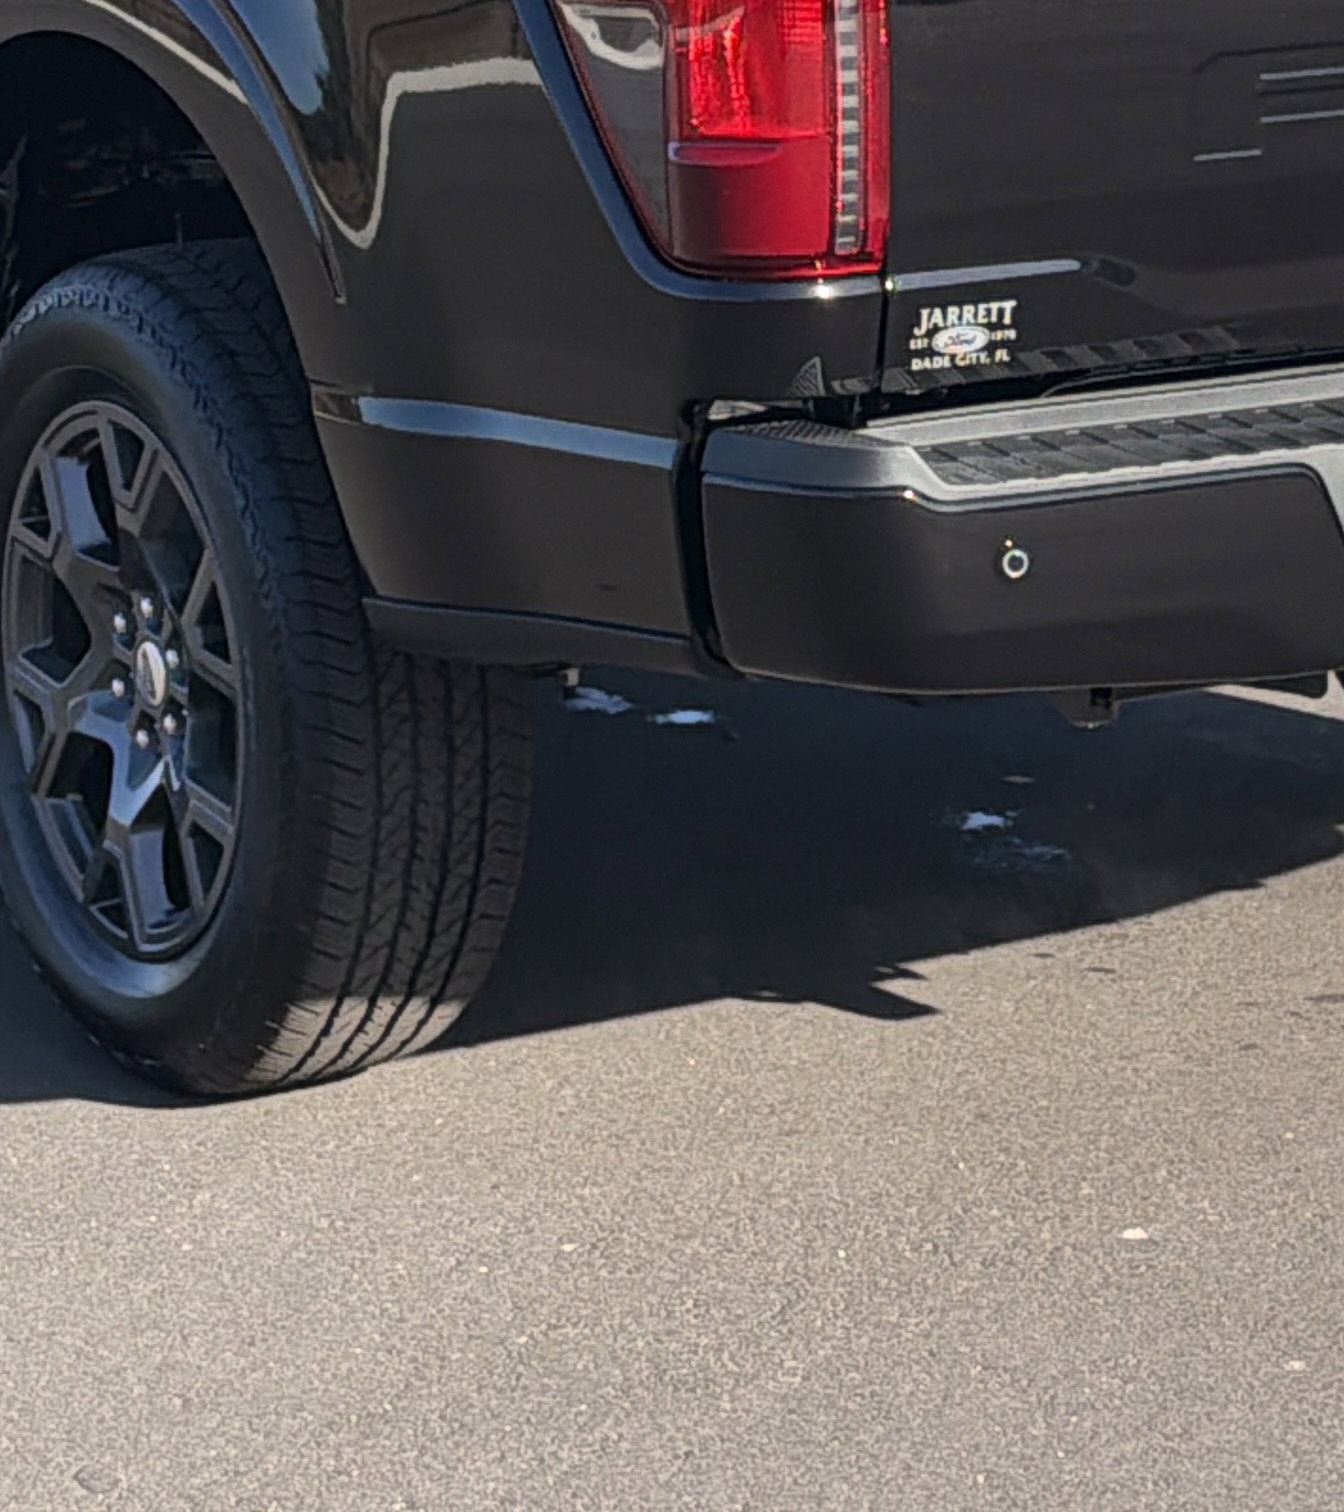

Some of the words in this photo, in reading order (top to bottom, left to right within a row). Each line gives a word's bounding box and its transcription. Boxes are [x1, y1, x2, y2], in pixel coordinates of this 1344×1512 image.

[914, 300, 1018, 336] JARRETT
[912, 355, 951, 371] DADE
[995, 349, 1010, 362] FL
